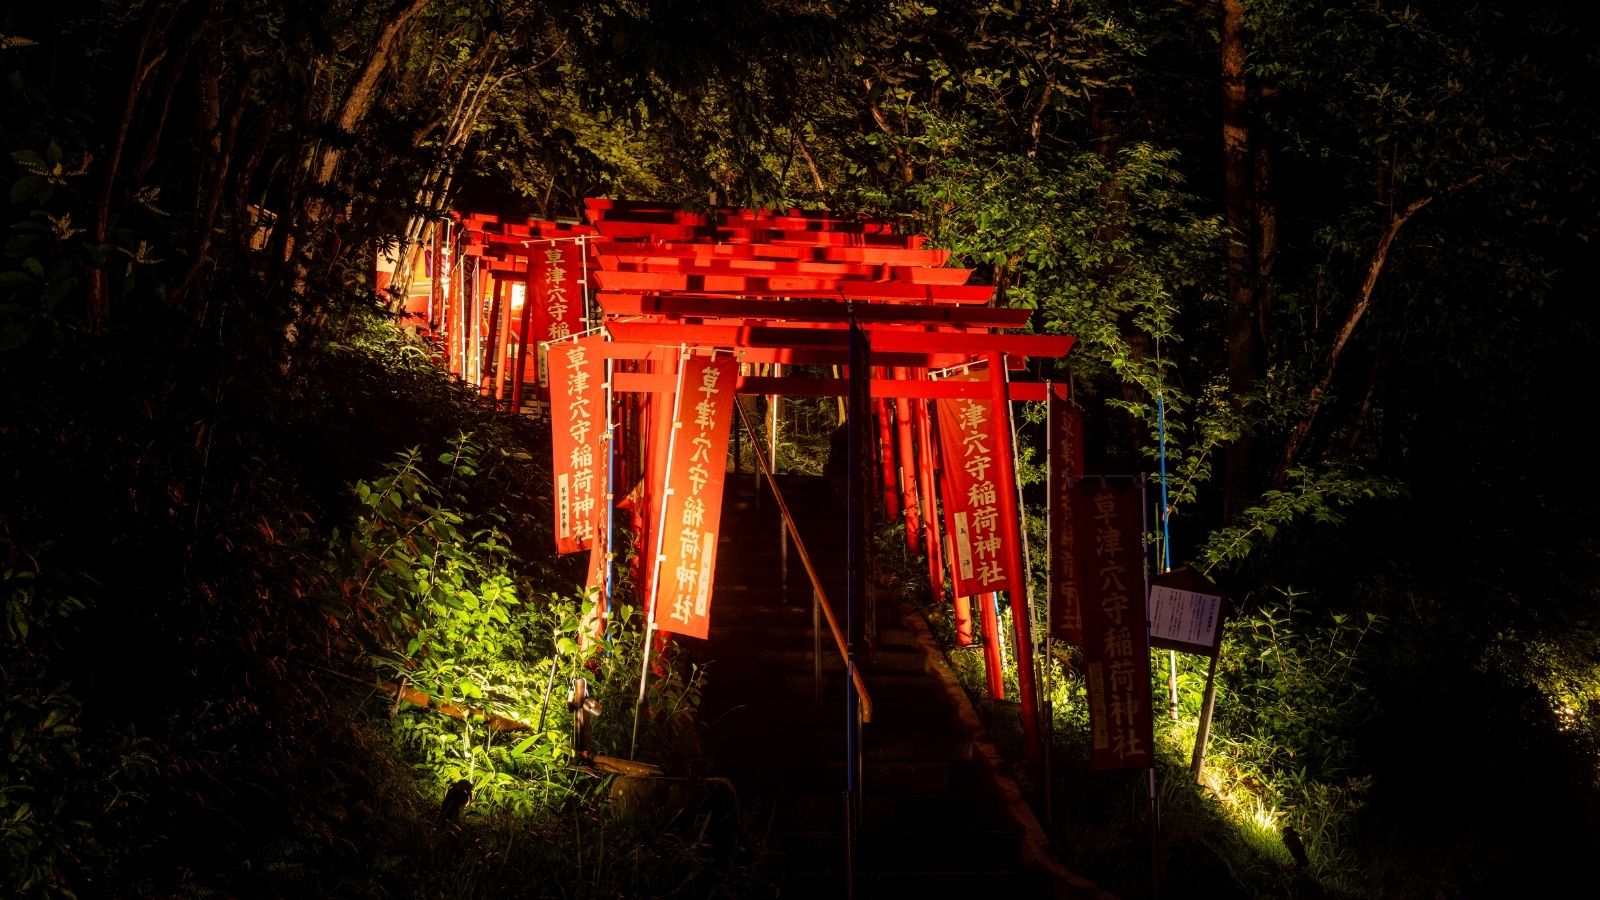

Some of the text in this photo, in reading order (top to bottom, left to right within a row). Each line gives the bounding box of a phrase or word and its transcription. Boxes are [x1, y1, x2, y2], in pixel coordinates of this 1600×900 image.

[566, 346, 595, 545] 草津穴守稲荷神社
[956, 378, 1006, 587] 津穴守稲荷神社
[1094, 493, 1146, 761] 草津穴守稲荷神社
